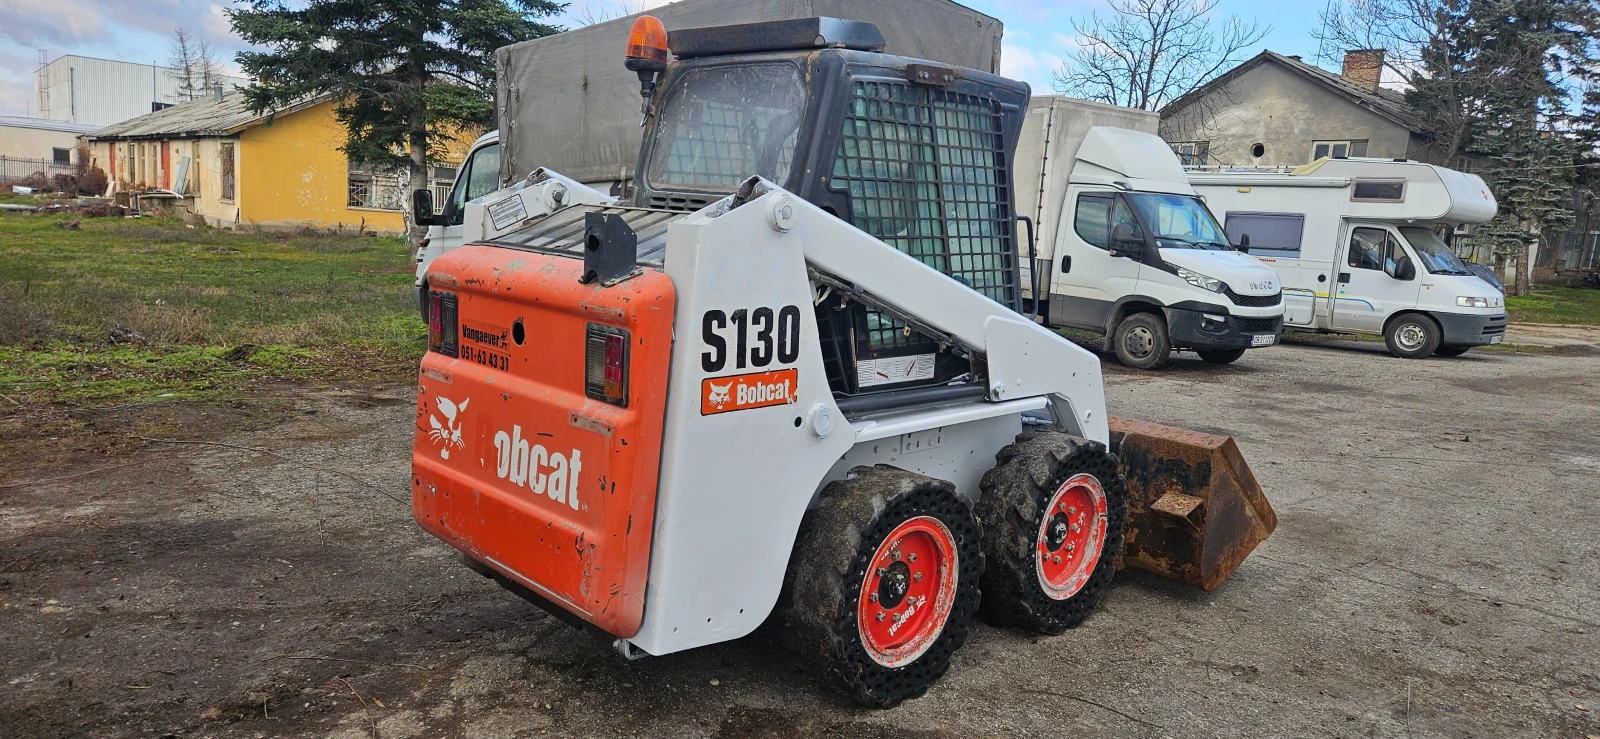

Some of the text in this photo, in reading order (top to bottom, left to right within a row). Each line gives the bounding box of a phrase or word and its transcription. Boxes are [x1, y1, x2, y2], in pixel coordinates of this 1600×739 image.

[462, 324, 499, 347] Vangaever
[702, 305, 801, 373] S130
[461, 345, 509, 372] 051-63 43 31
[736, 379, 790, 405] Bobcat
